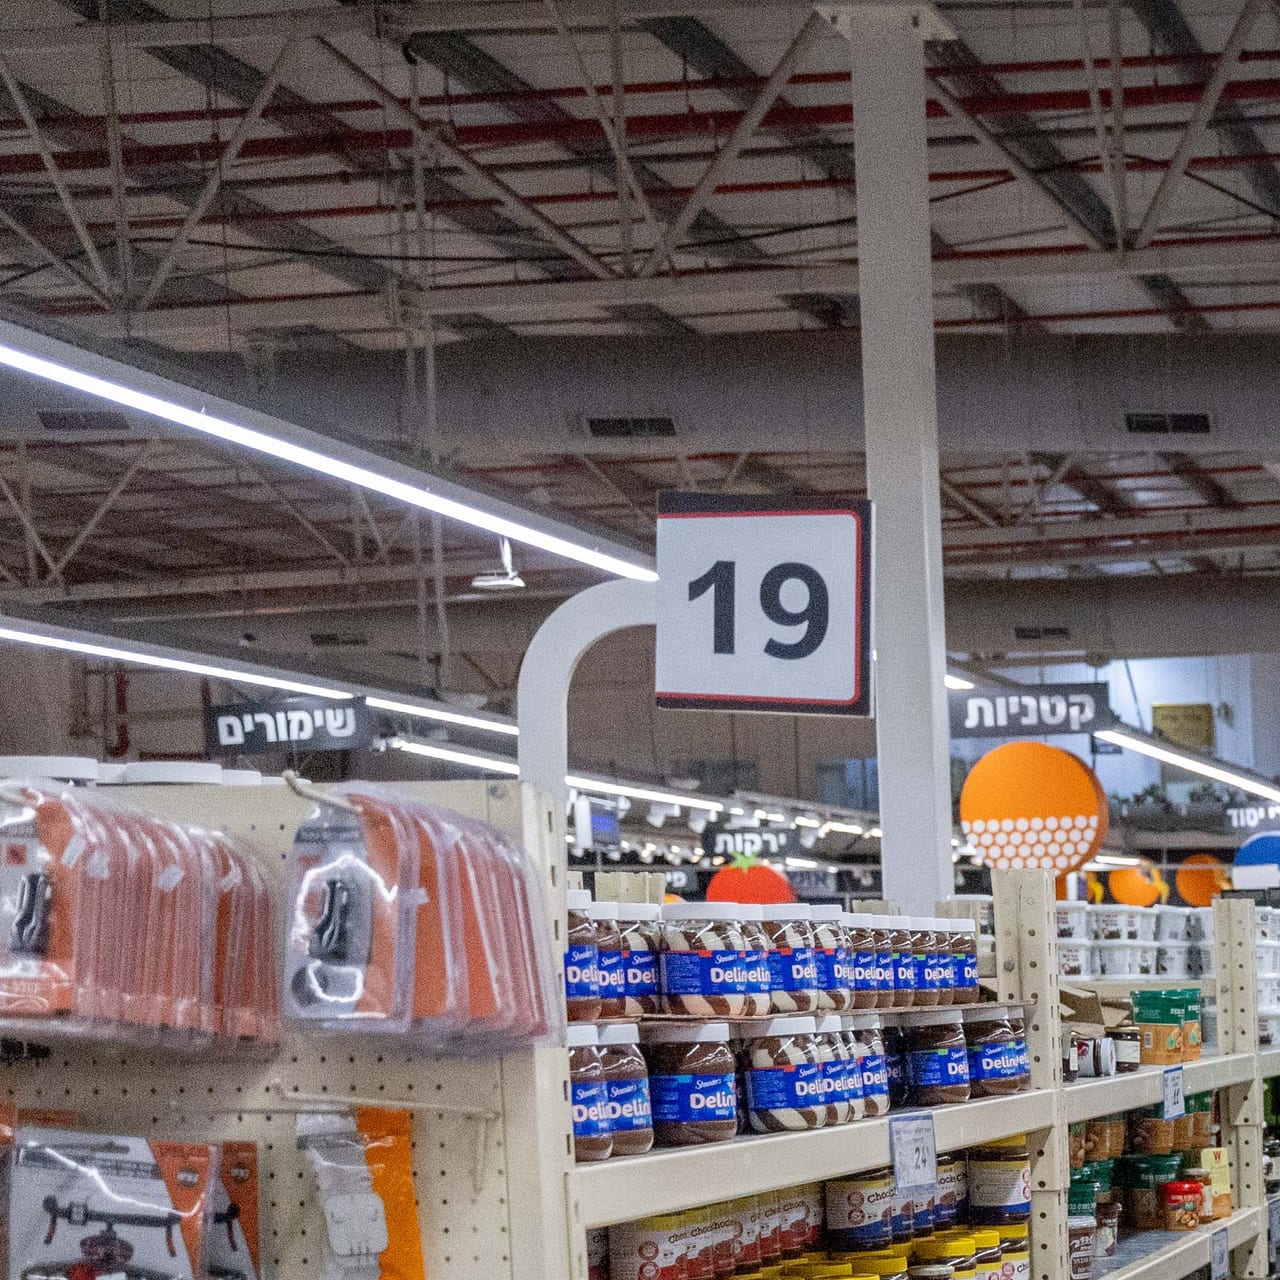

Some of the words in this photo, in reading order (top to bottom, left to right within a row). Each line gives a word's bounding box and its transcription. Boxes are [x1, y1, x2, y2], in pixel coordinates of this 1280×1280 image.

[688, 561, 832, 661] 19
[216, 706, 358, 748] שימורים
[964, 692, 1095, 731] קטניות
[715, 832, 788, 856] ירקות
